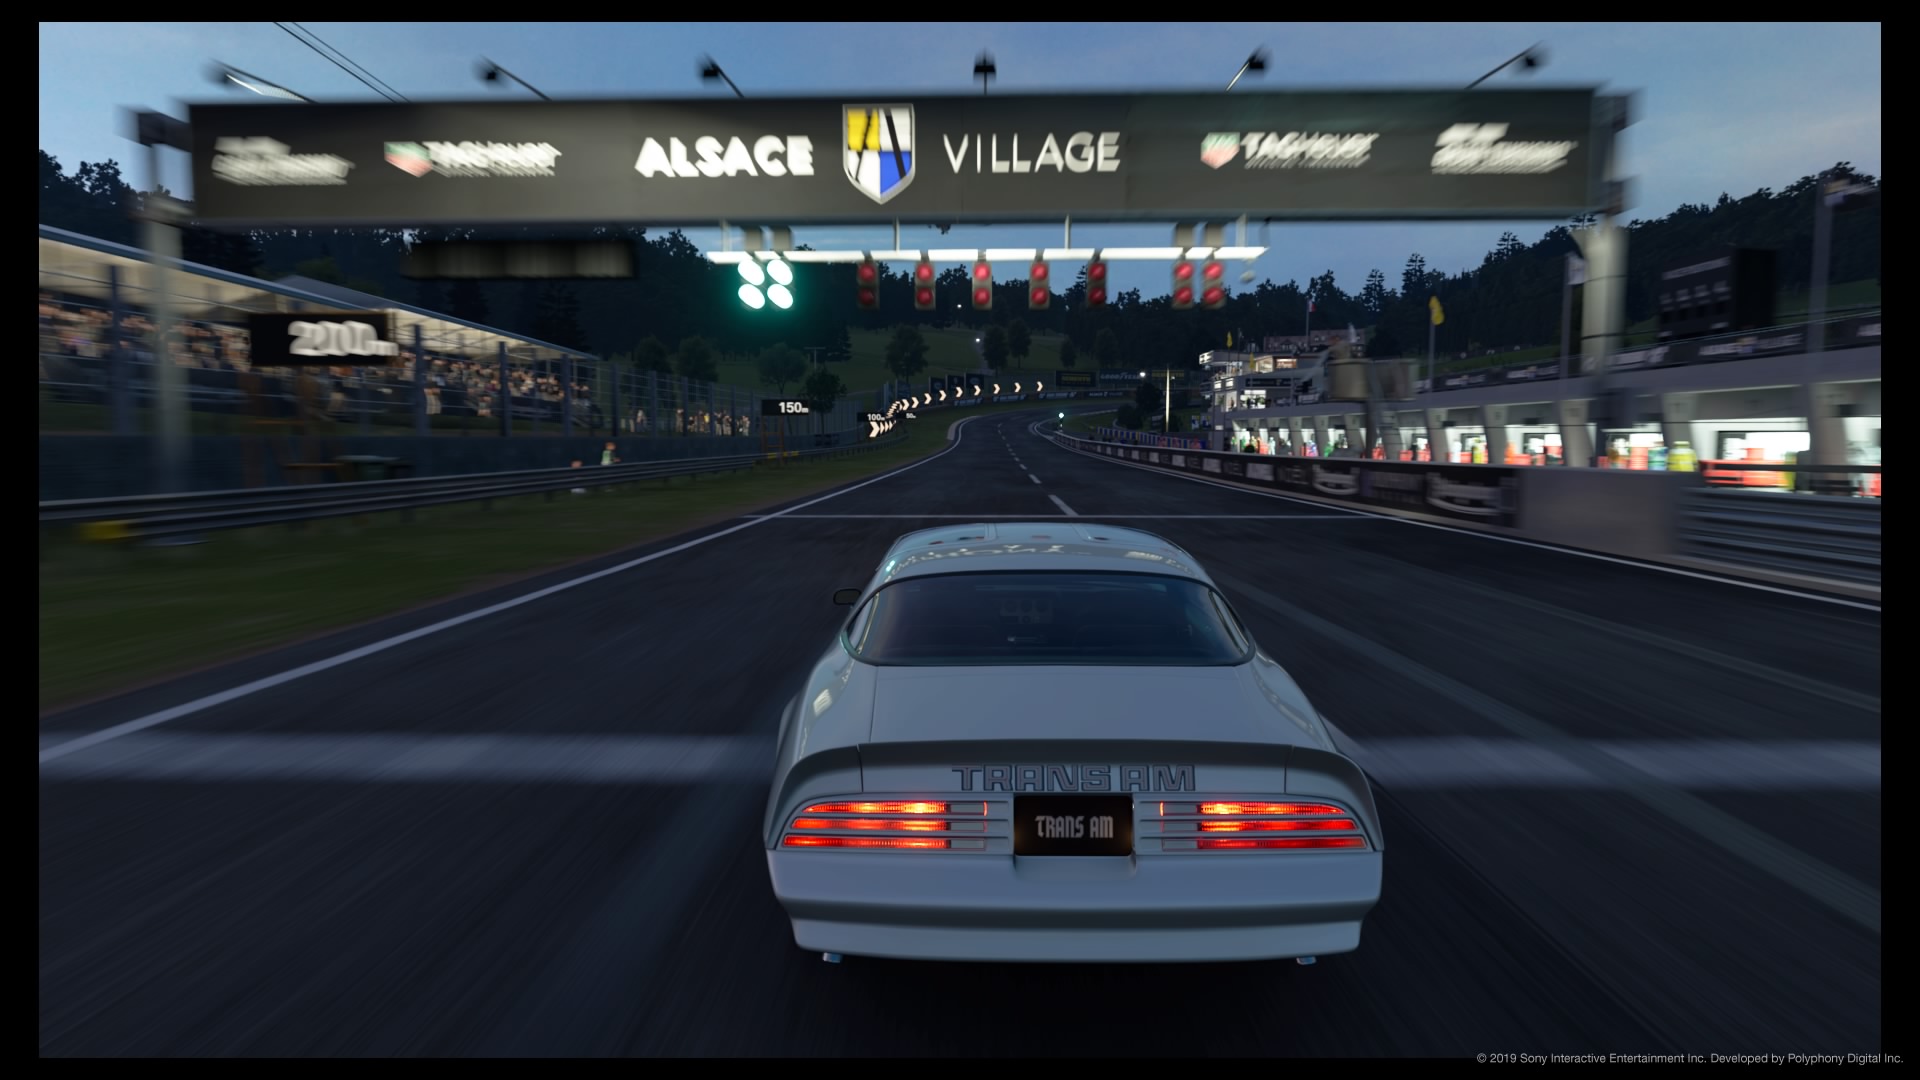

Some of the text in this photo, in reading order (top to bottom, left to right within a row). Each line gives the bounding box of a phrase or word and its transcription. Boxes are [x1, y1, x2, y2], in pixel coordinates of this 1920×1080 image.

[634, 131, 1122, 178] ALSACE VILLAGE
[777, 400, 810, 415] 150m
[951, 764, 1196, 791] TRANS AM
[1034, 815, 1114, 839] TRANS AM
